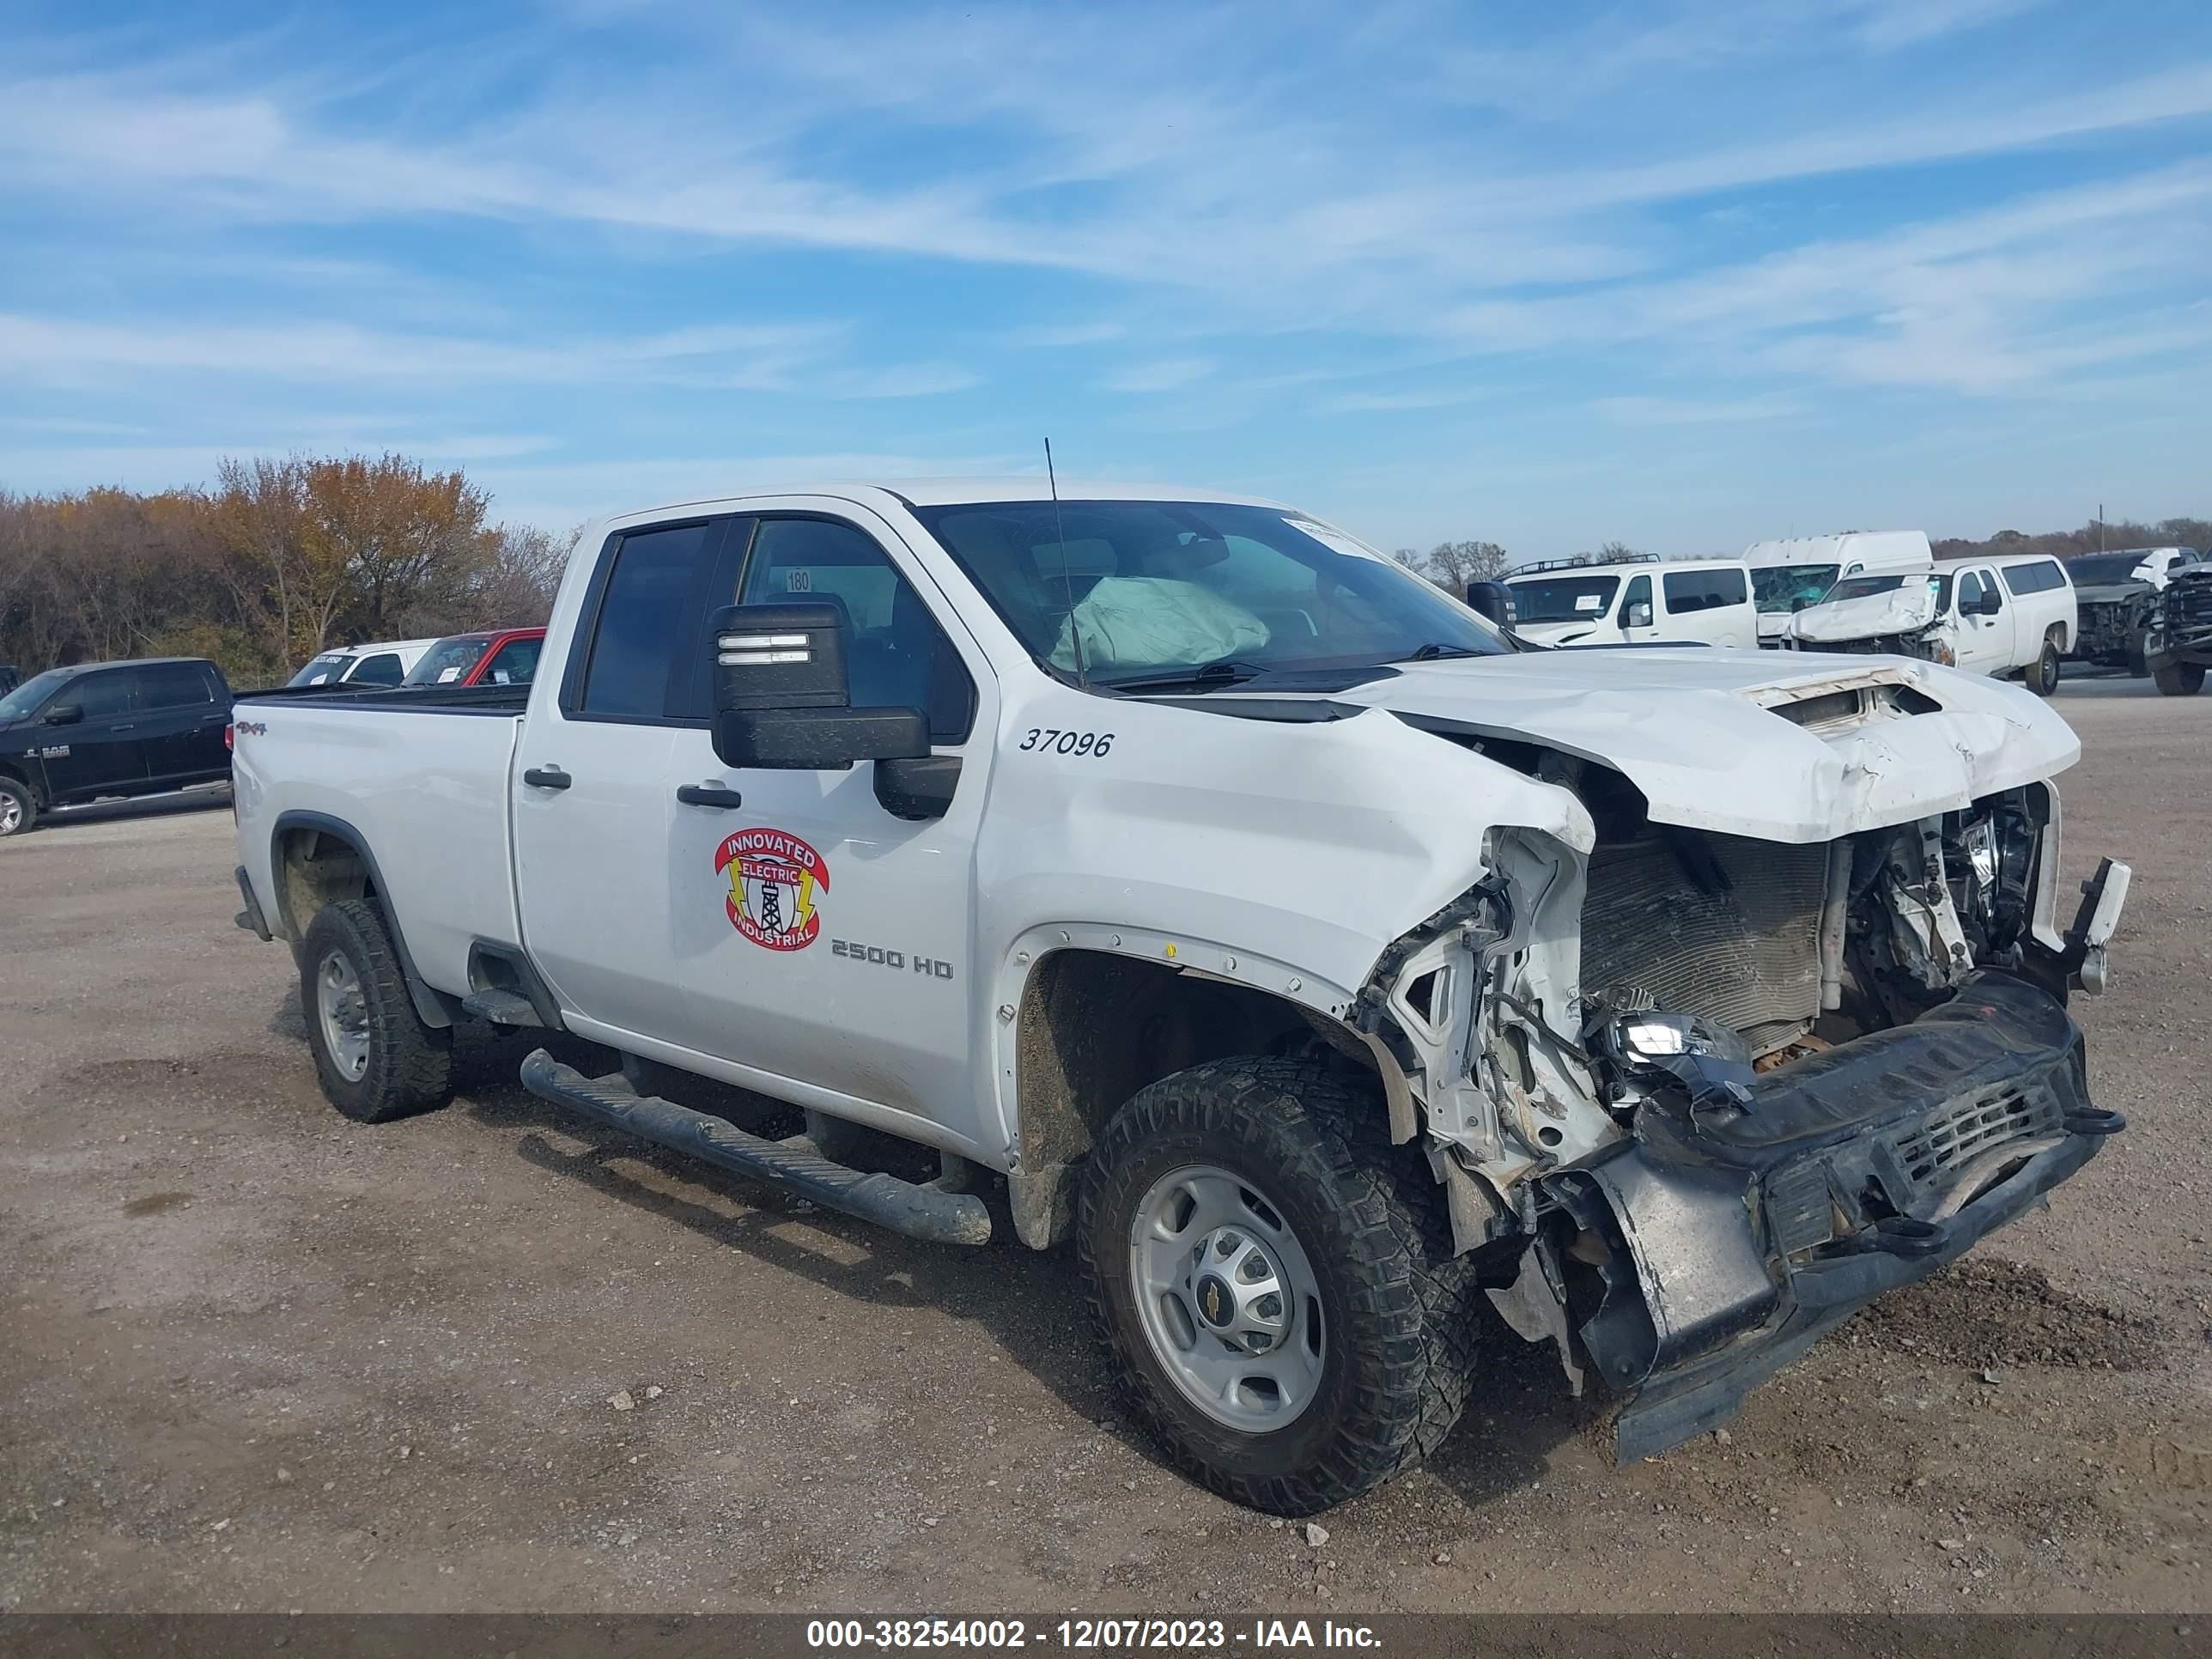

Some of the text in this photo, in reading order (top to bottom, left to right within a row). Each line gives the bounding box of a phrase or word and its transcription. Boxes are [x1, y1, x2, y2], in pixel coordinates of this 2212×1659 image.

[788, 571, 809, 591] 180
[1019, 728, 1115, 757] 37096
[727, 833, 816, 868] INNOVATED
[742, 863, 798, 883] ELECTRIC
[733, 912, 814, 946] INDUSTRIAL
[831, 938, 953, 979] 2500 HD
